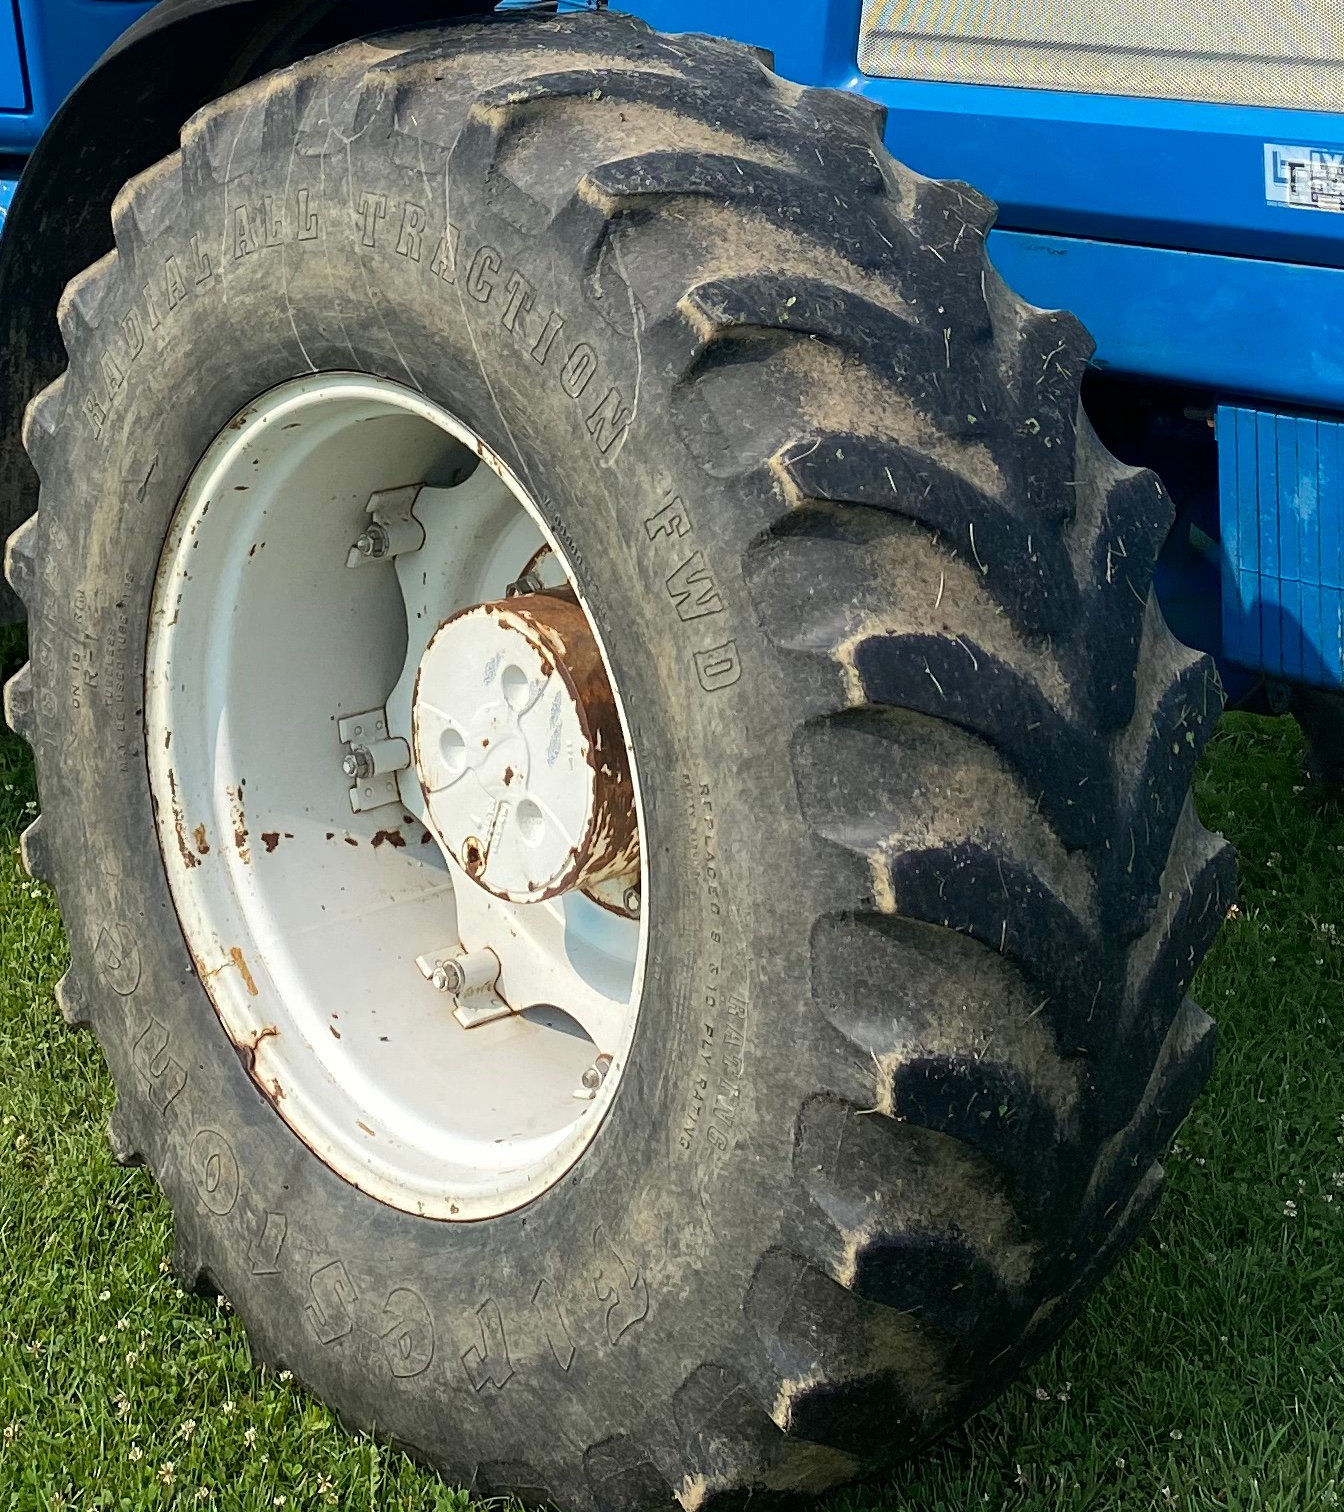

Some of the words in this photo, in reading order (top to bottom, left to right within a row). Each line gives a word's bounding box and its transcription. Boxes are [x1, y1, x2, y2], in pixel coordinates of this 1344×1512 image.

[82, 232, 213, 440] RADIAL
[233, 188, 318, 260] ALL
[357, 190, 632, 454] TRACTION
[644, 495, 742, 692] FWD
[71, 685, 81, 710] ON
[679, 1077, 707, 1151] RATING
[707, 993, 749, 1152] RATING
[94, 920, 649, 1392] Firestone
